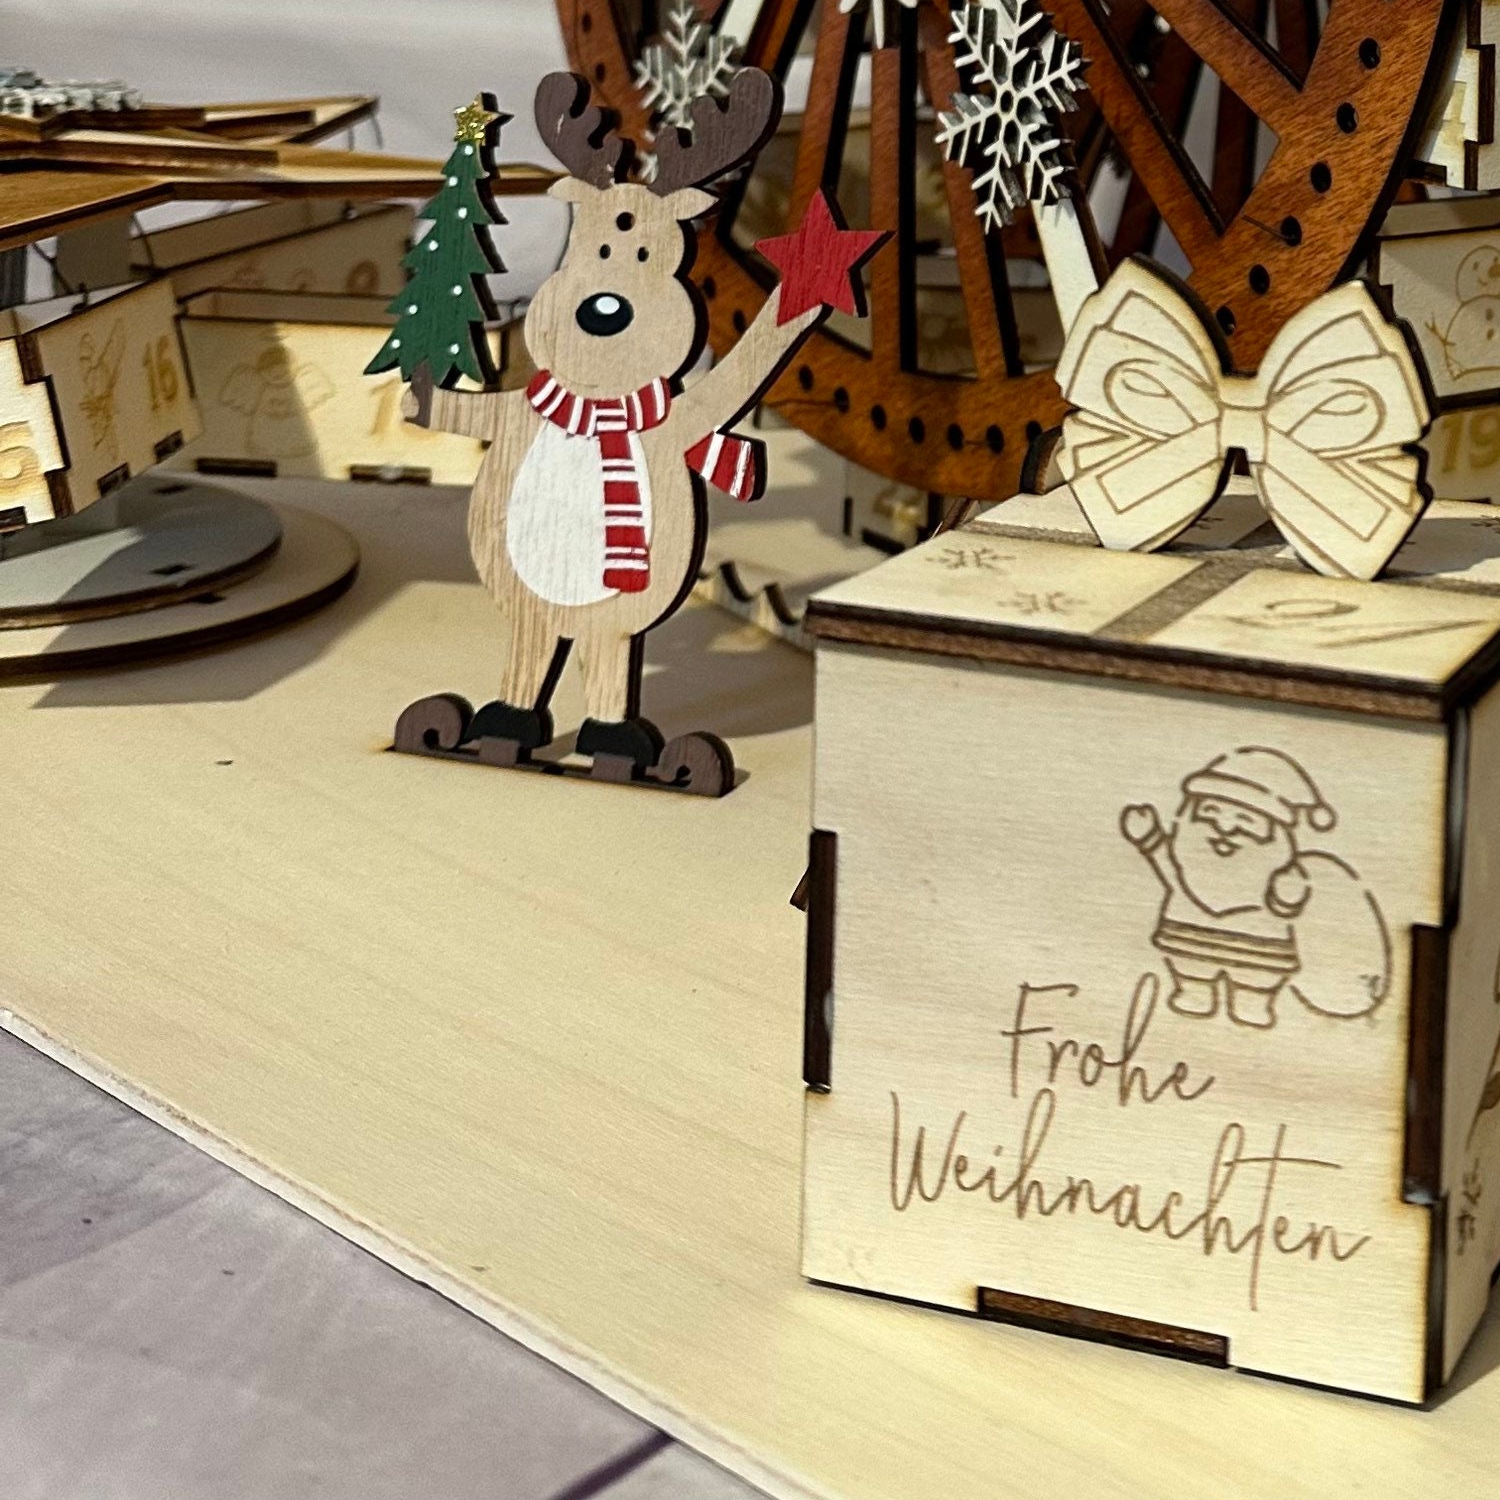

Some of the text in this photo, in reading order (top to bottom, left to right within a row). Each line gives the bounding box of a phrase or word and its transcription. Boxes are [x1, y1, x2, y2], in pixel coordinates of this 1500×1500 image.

[142, 334, 180, 412] 16
[1000, 971, 1216, 1107] Frohe
[889, 1087, 1373, 1312] Weihnachten
